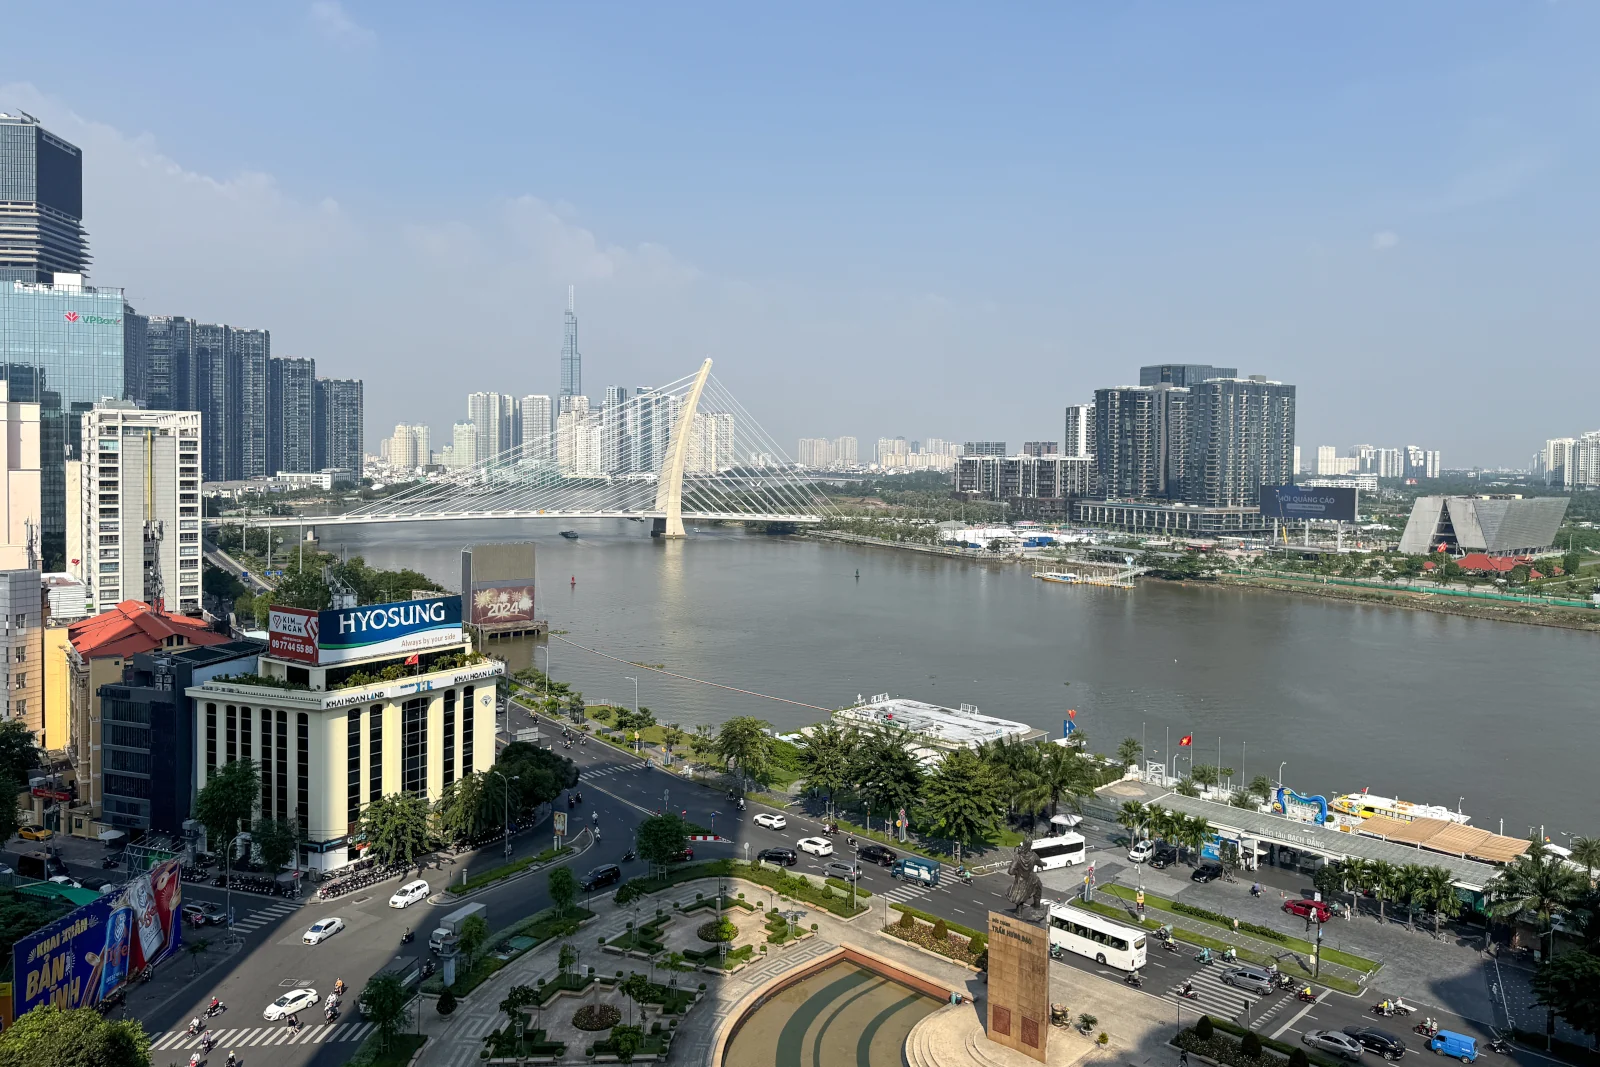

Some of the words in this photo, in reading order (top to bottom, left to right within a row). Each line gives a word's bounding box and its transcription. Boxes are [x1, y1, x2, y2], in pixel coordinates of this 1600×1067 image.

[82, 315, 121, 325] VPBank
[1319, 495, 1335, 504] CÁO
[487, 601, 519, 617] 2024
[282, 616, 296, 625] KIM
[338, 602, 445, 634] HYOSUNG
[401, 639, 422, 647] Always
[422, 637, 430, 645] by
[431, 636, 443, 644] your
[454, 674, 469, 683] KHAI
[469, 670, 487, 680] HOAN
[487, 668, 503, 676] LAND
[326, 698, 344, 708] KHAI
[344, 694, 366, 704] HOAN
[366, 691, 385, 700] LAND
[37, 932, 60, 958] KHAI
[26, 953, 65, 1002] BẢN
[39, 976, 80, 1010] ĨNH
